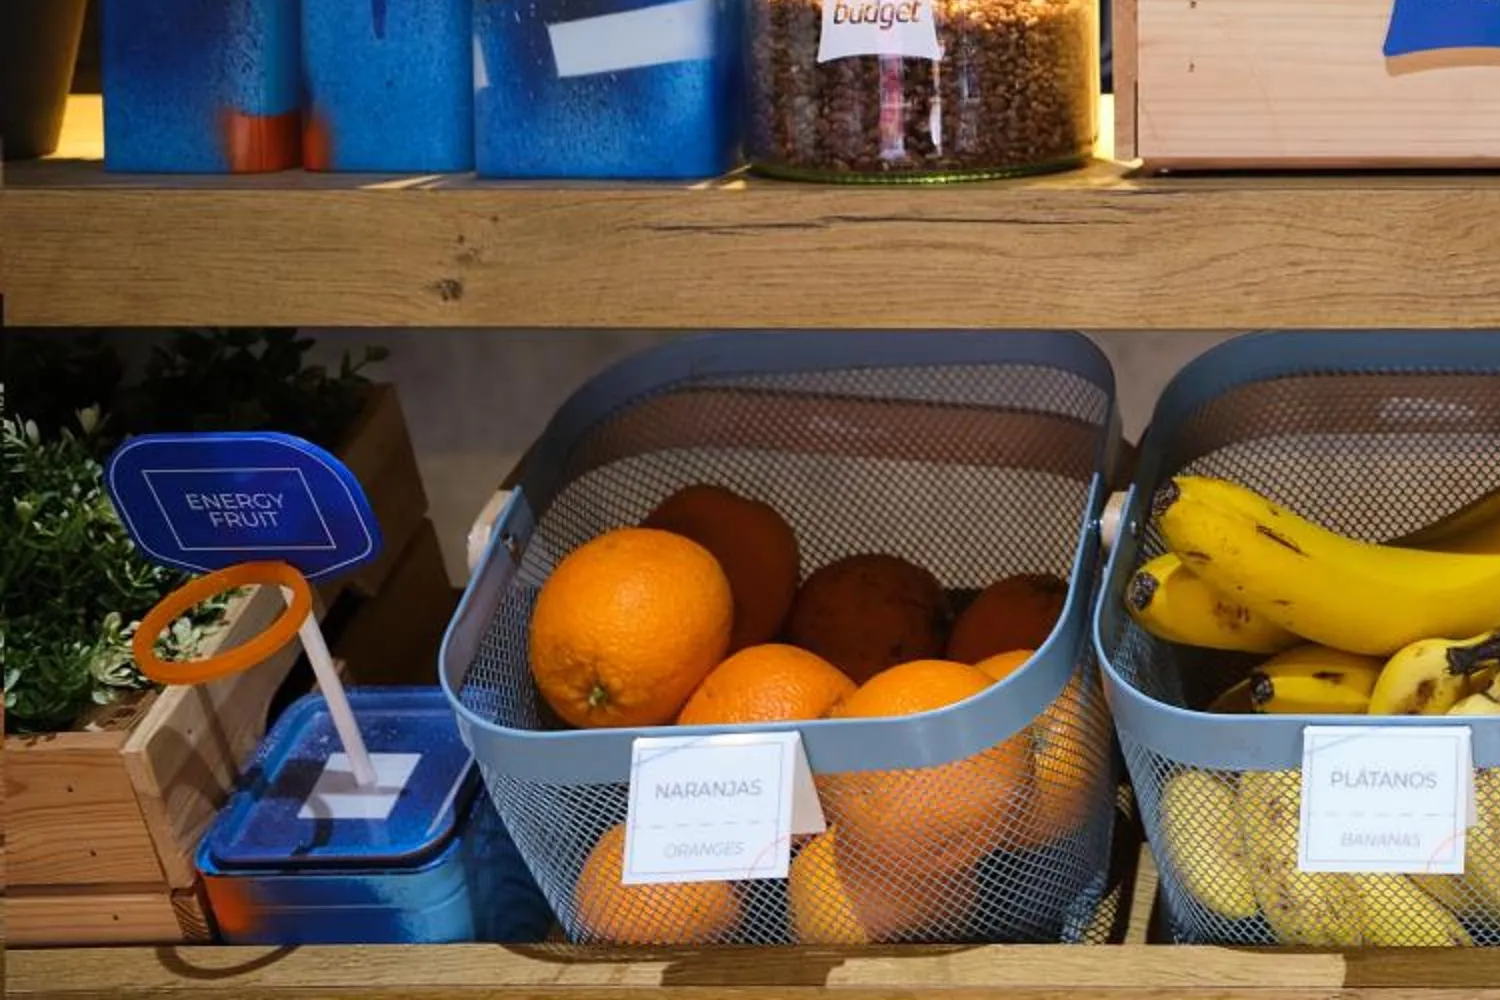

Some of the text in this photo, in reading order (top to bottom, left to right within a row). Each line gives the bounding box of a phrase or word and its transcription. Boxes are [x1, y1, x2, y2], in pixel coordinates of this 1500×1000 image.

[185, 493, 284, 510] ENERGY
[209, 511, 280, 528] FRUIT
[655, 778, 763, 799] NARANJAS
[1341, 832, 1421, 848] BANANAS
[663, 841, 745, 859] ORANGES
